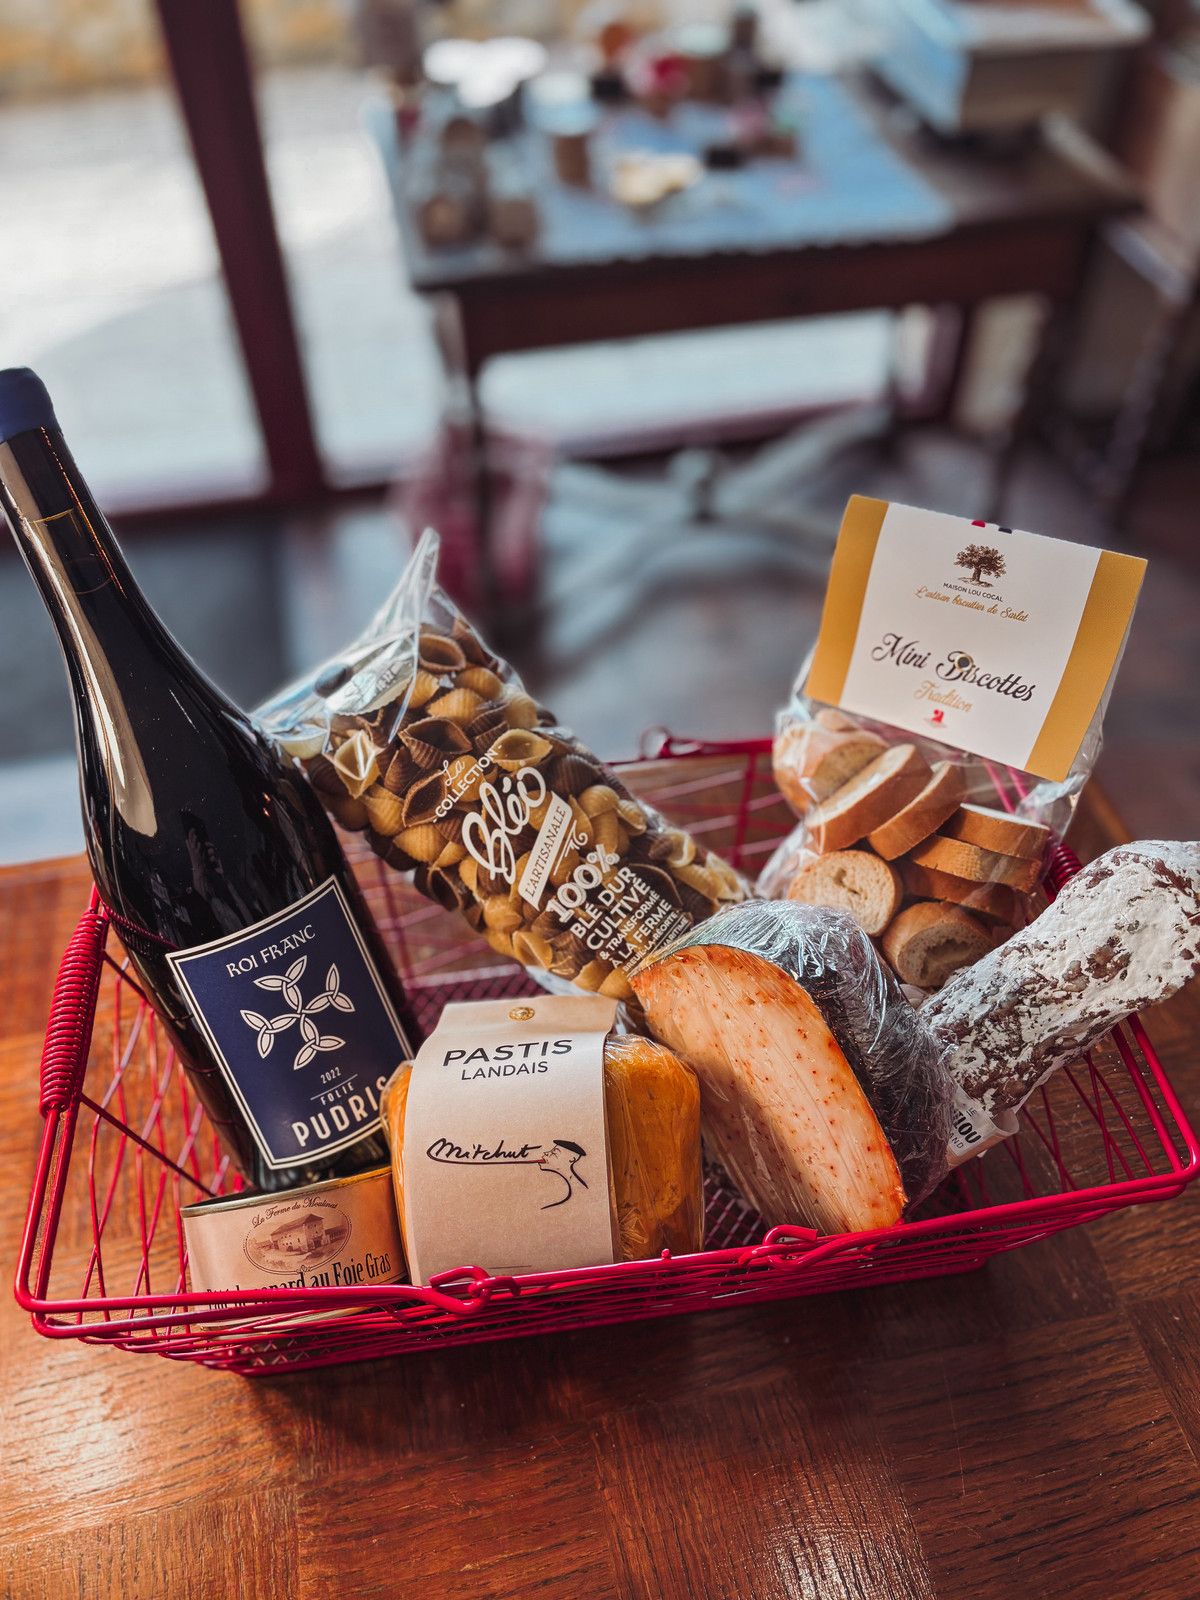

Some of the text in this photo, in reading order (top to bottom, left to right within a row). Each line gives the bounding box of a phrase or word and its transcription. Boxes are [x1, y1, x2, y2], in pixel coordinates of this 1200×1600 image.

[942, 582, 967, 593] MAISON
[982, 592, 1003, 602] COCAL
[986, 604, 998, 615] de
[1000, 606, 1030, 622] Sarlat
[871, 632, 1036, 702] Mini Biscottes
[913, 680, 972, 712] Tradition
[525, 805, 566, 898] L'ARTISANALE
[545, 843, 620, 923] 100%
[570, 866, 637, 939] BLÉ DUR
[586, 876, 651, 950] CULTIVÉ
[599, 889, 661, 960] & TRANSFORMÉ
[618, 942, 638, 959] LA
[633, 898, 673, 943] FERME
[225, 924, 316, 978] ROI FRANC
[319, 1065, 343, 1085] 2022
[442, 1039, 573, 1067] PASTIS
[461, 1061, 549, 1081] LANDAIS
[319, 1081, 355, 1106] FOLIE
[310, 1272, 331, 1288] au
[331, 1260, 365, 1288] Foie
[364, 1252, 393, 1279] Gras
